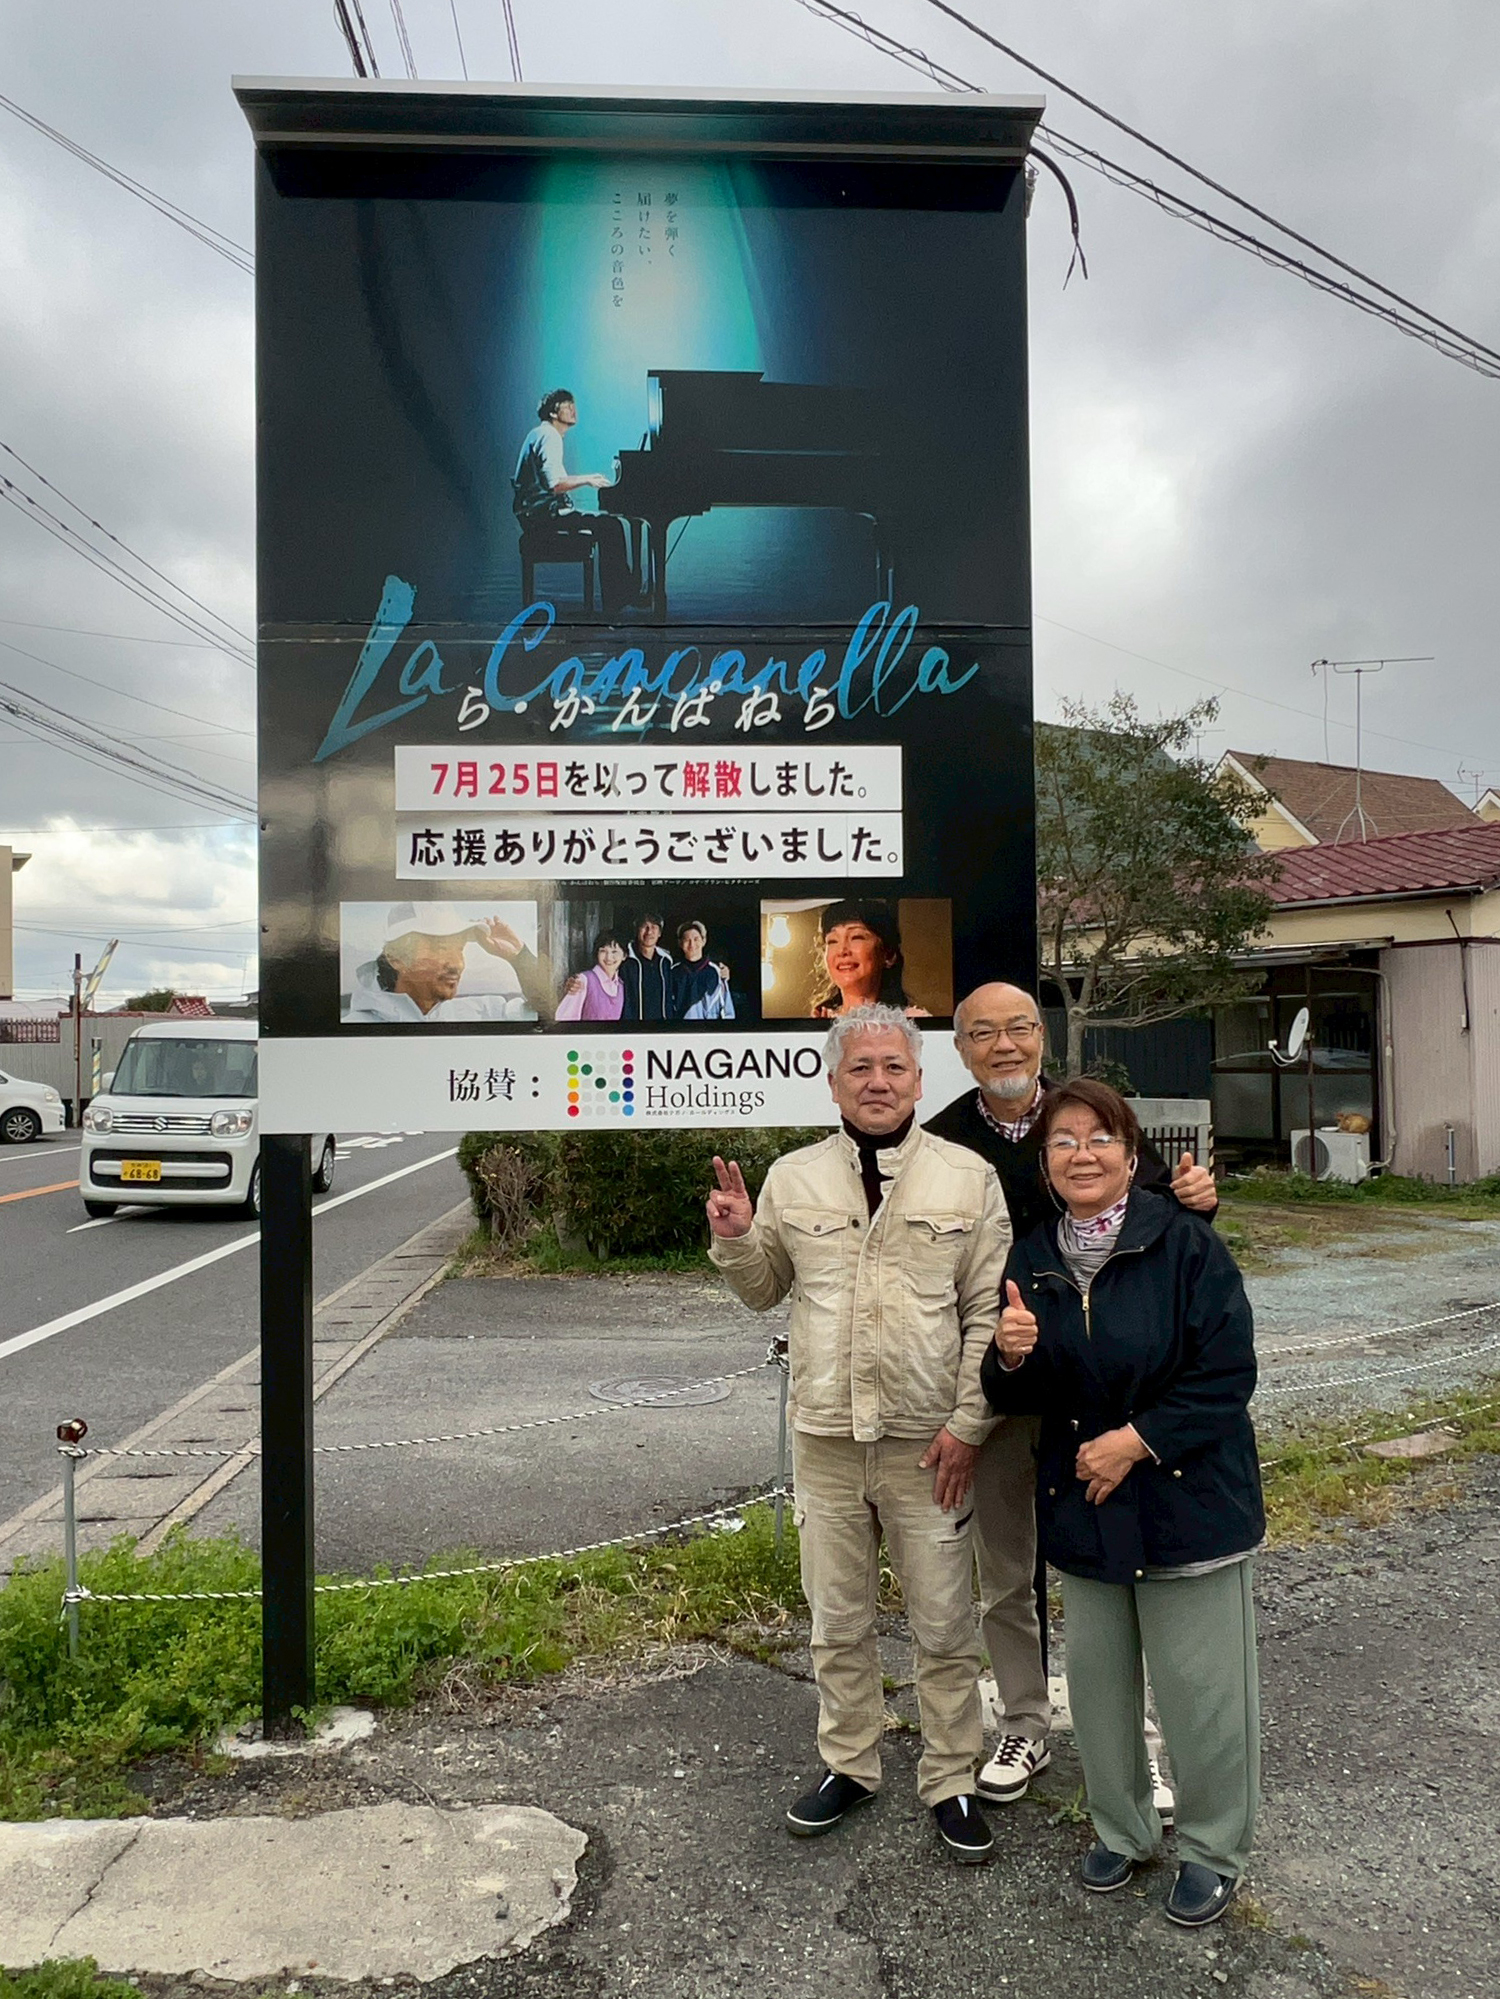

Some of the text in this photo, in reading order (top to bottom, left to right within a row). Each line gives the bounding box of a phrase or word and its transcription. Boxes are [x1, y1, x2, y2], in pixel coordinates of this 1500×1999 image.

[664, 192, 679, 257] 夢を弾く
[610, 193, 625, 307] こころの音色を
[312, 574, 979, 762] La Campanella
[456, 680, 837, 733] ら・かんぱねら
[430, 760, 868, 799] 7月25日を以って解散しました。
[409, 826, 899, 867] 応援ありがとうございました。
[647, 1047, 822, 1080] NAGANO
[645, 1083, 765, 1115] Holdings
